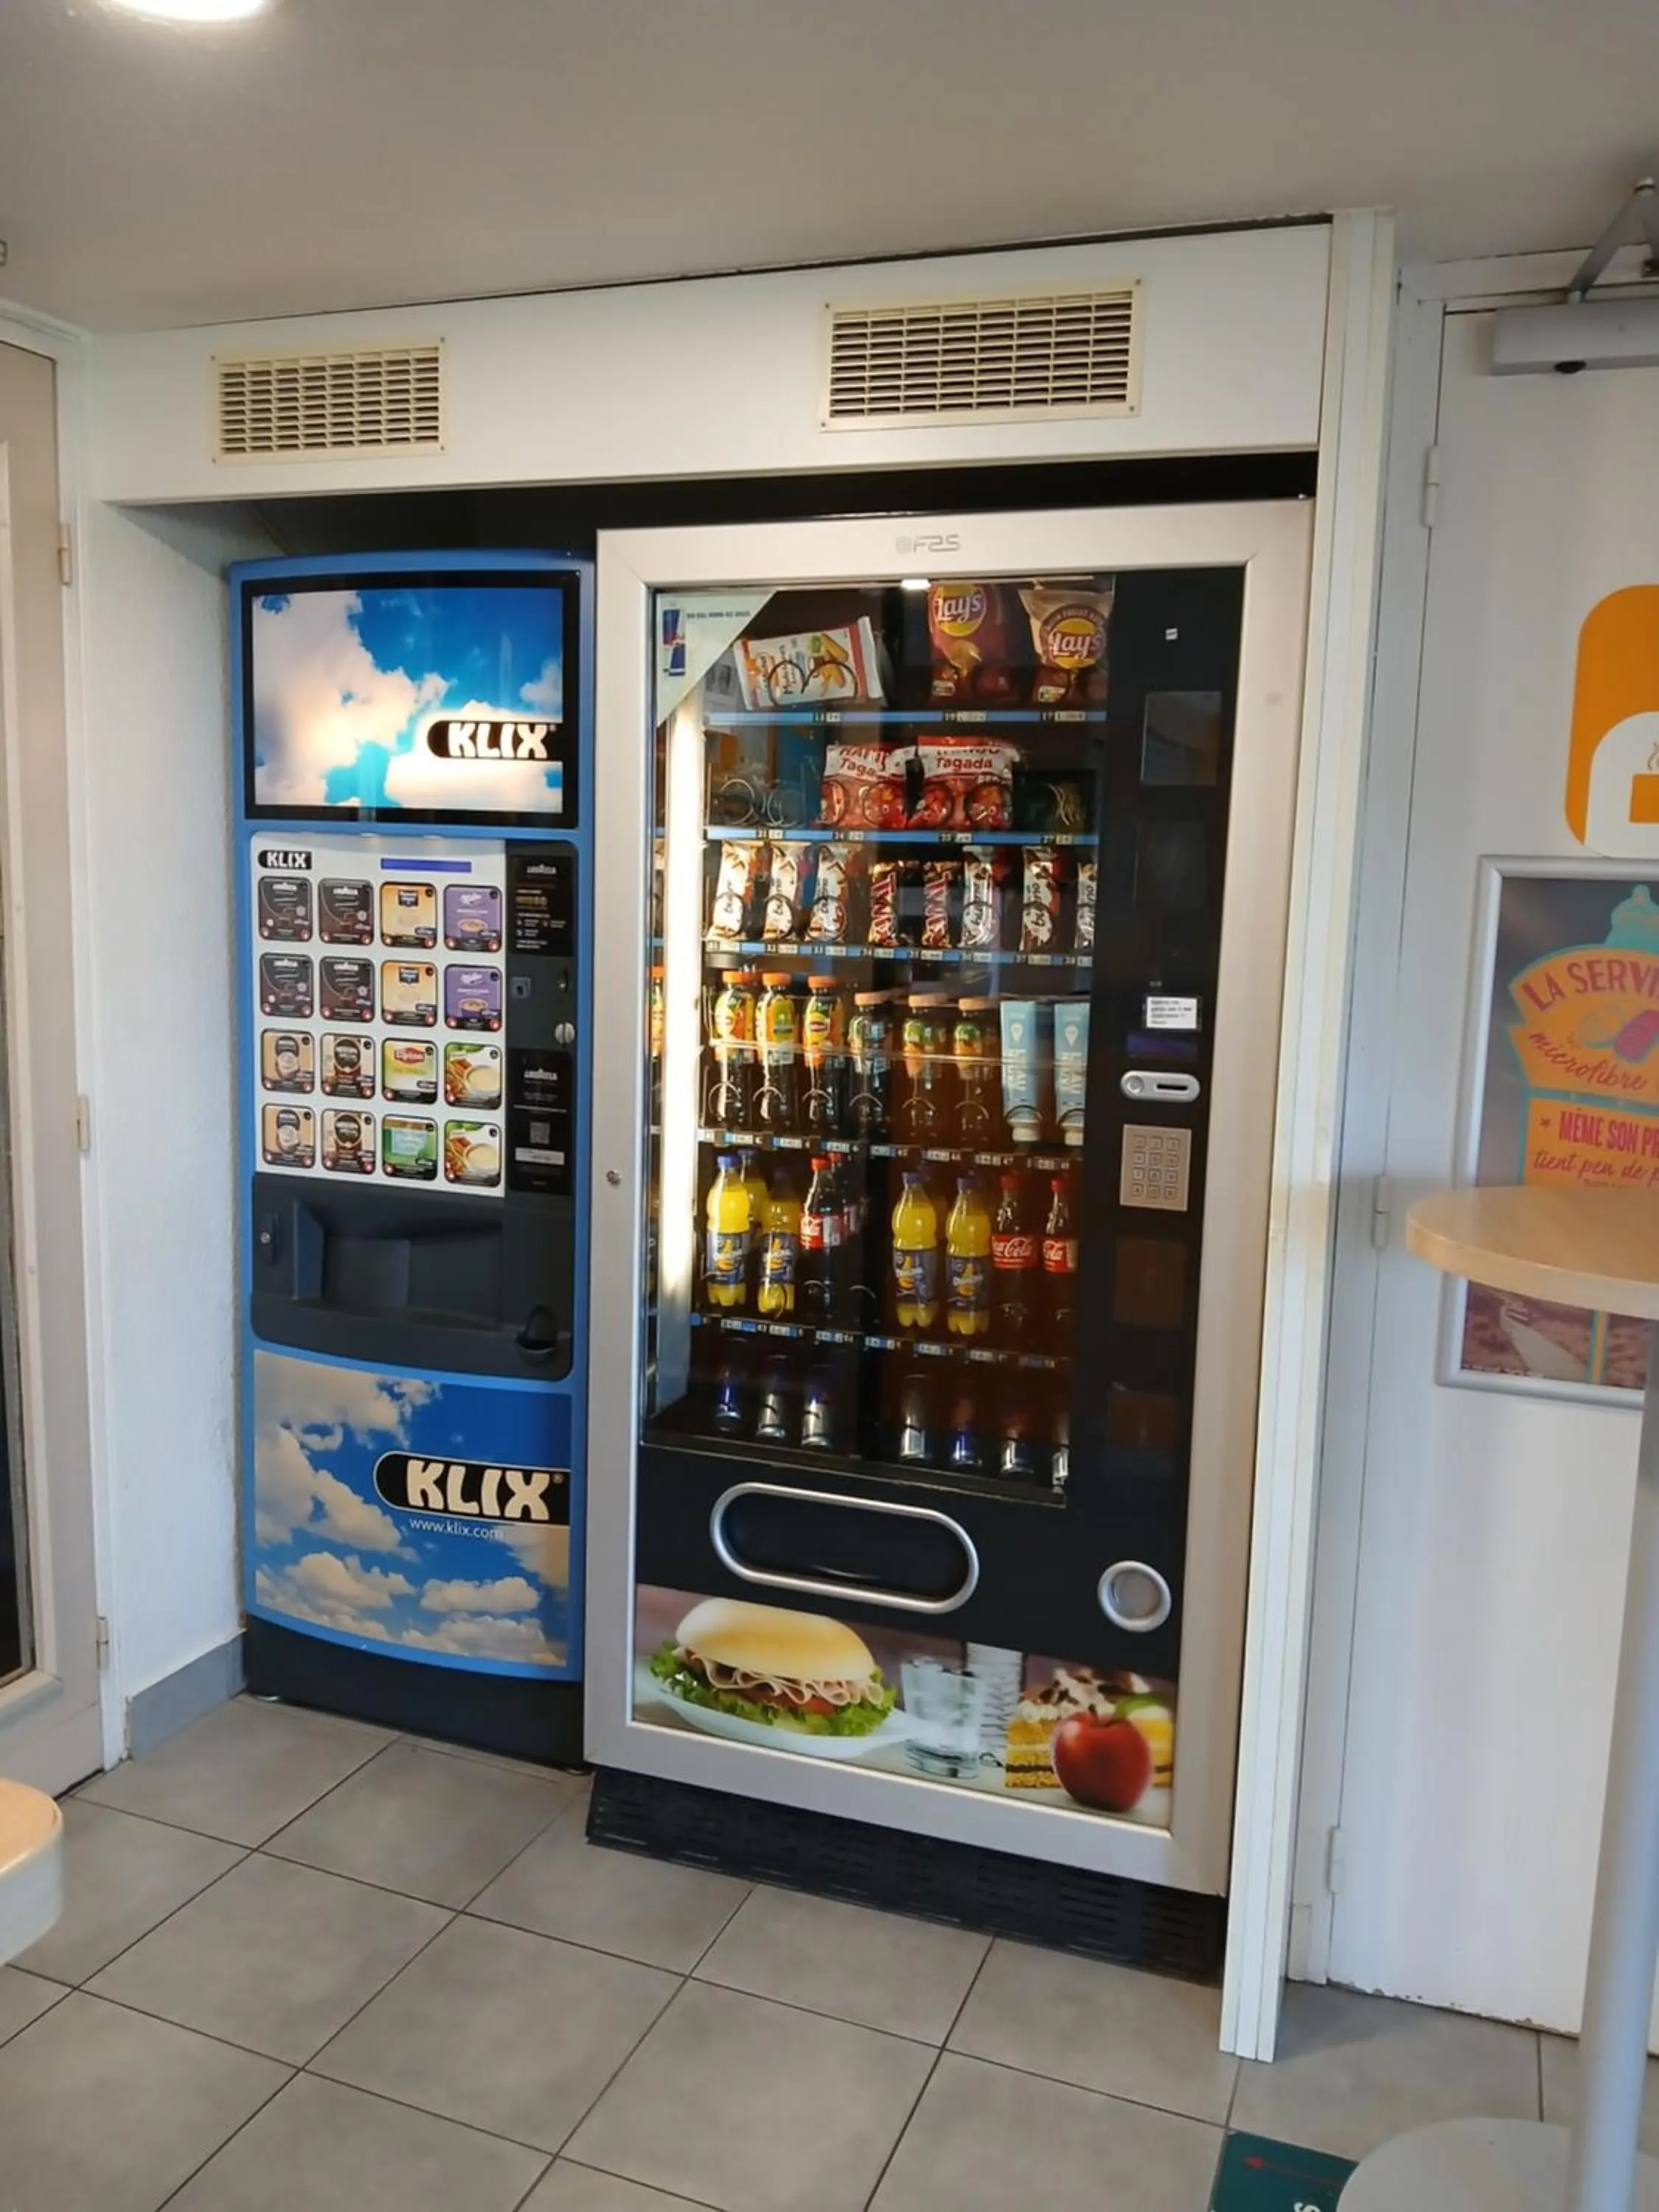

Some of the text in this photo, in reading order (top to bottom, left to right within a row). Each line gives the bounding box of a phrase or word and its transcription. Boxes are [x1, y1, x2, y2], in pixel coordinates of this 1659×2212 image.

[447, 723, 548, 759] KLIX
[936, 757, 993, 773] Tagada
[266, 851, 307, 869] KLIX
[1521, 971, 1566, 1012] LA
[407, 1458, 551, 1521] KLIX
[409, 1517, 504, 1540] www.klix.com
